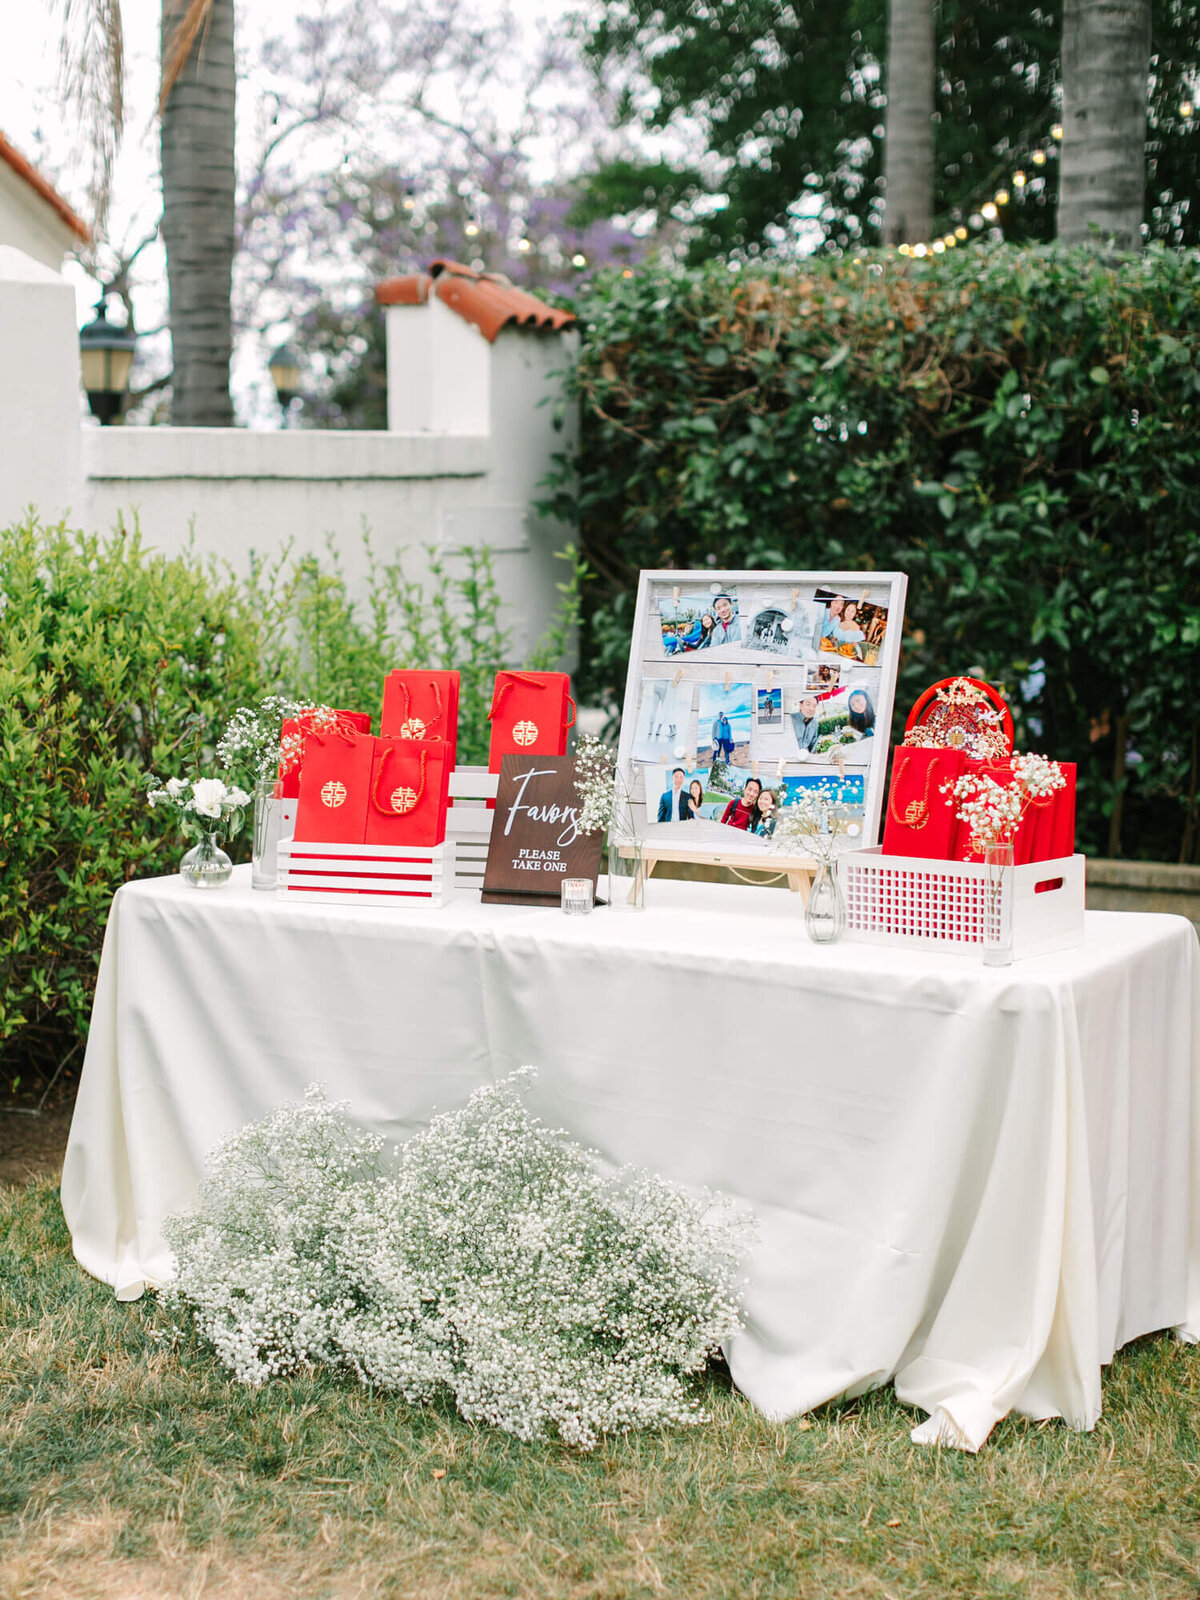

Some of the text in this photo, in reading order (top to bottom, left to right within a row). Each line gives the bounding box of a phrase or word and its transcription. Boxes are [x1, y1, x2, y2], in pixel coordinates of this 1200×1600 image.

[504, 767, 583, 847] Favors
[518, 848, 561, 861] PLEASE
[512, 859, 568, 873] TAKE ONE
